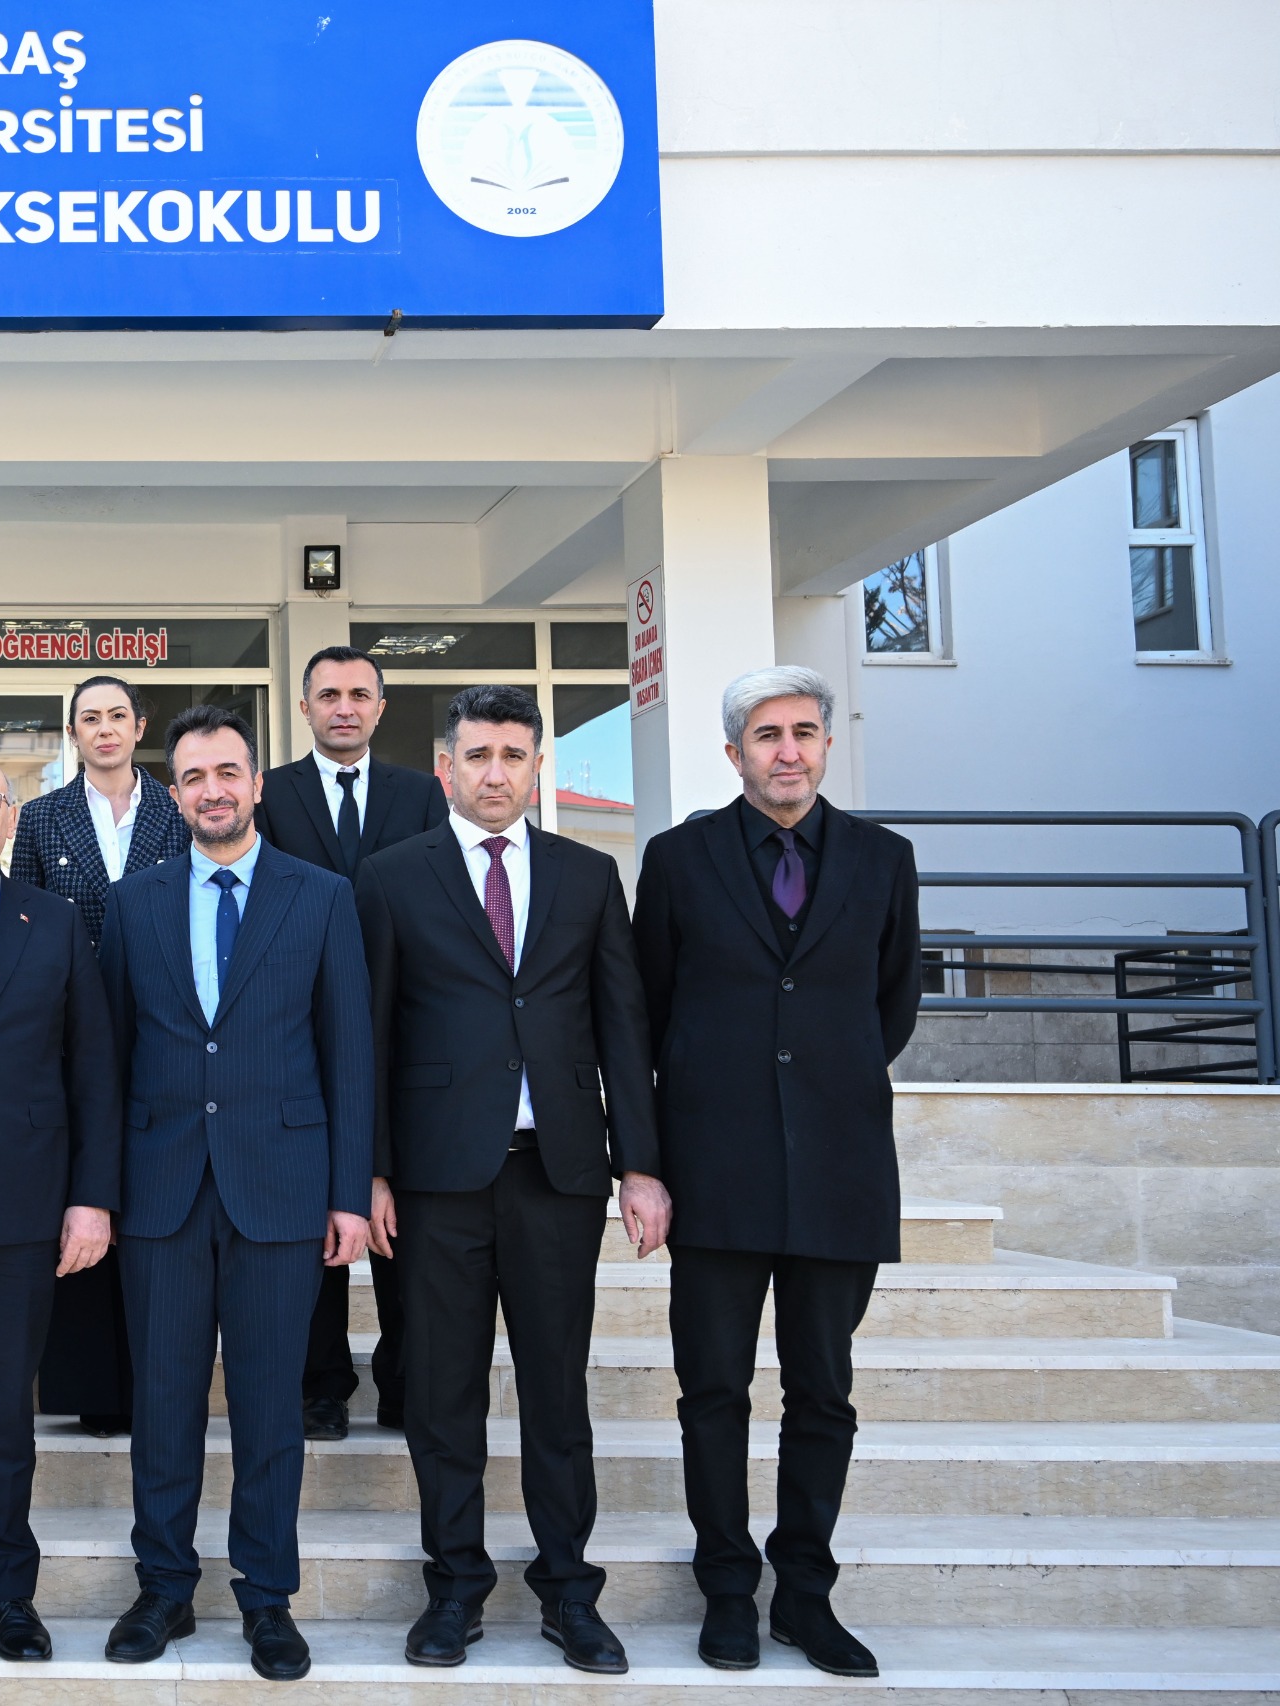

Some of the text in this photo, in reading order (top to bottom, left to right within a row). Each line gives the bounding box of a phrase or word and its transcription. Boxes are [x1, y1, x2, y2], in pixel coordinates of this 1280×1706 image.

[506, 207, 537, 215] 2002
[96, 627, 167, 666] GİRİŞİ
[631, 646, 663, 687] SİGARA İÇMEK
[637, 682, 658, 707] YASAKTIR
